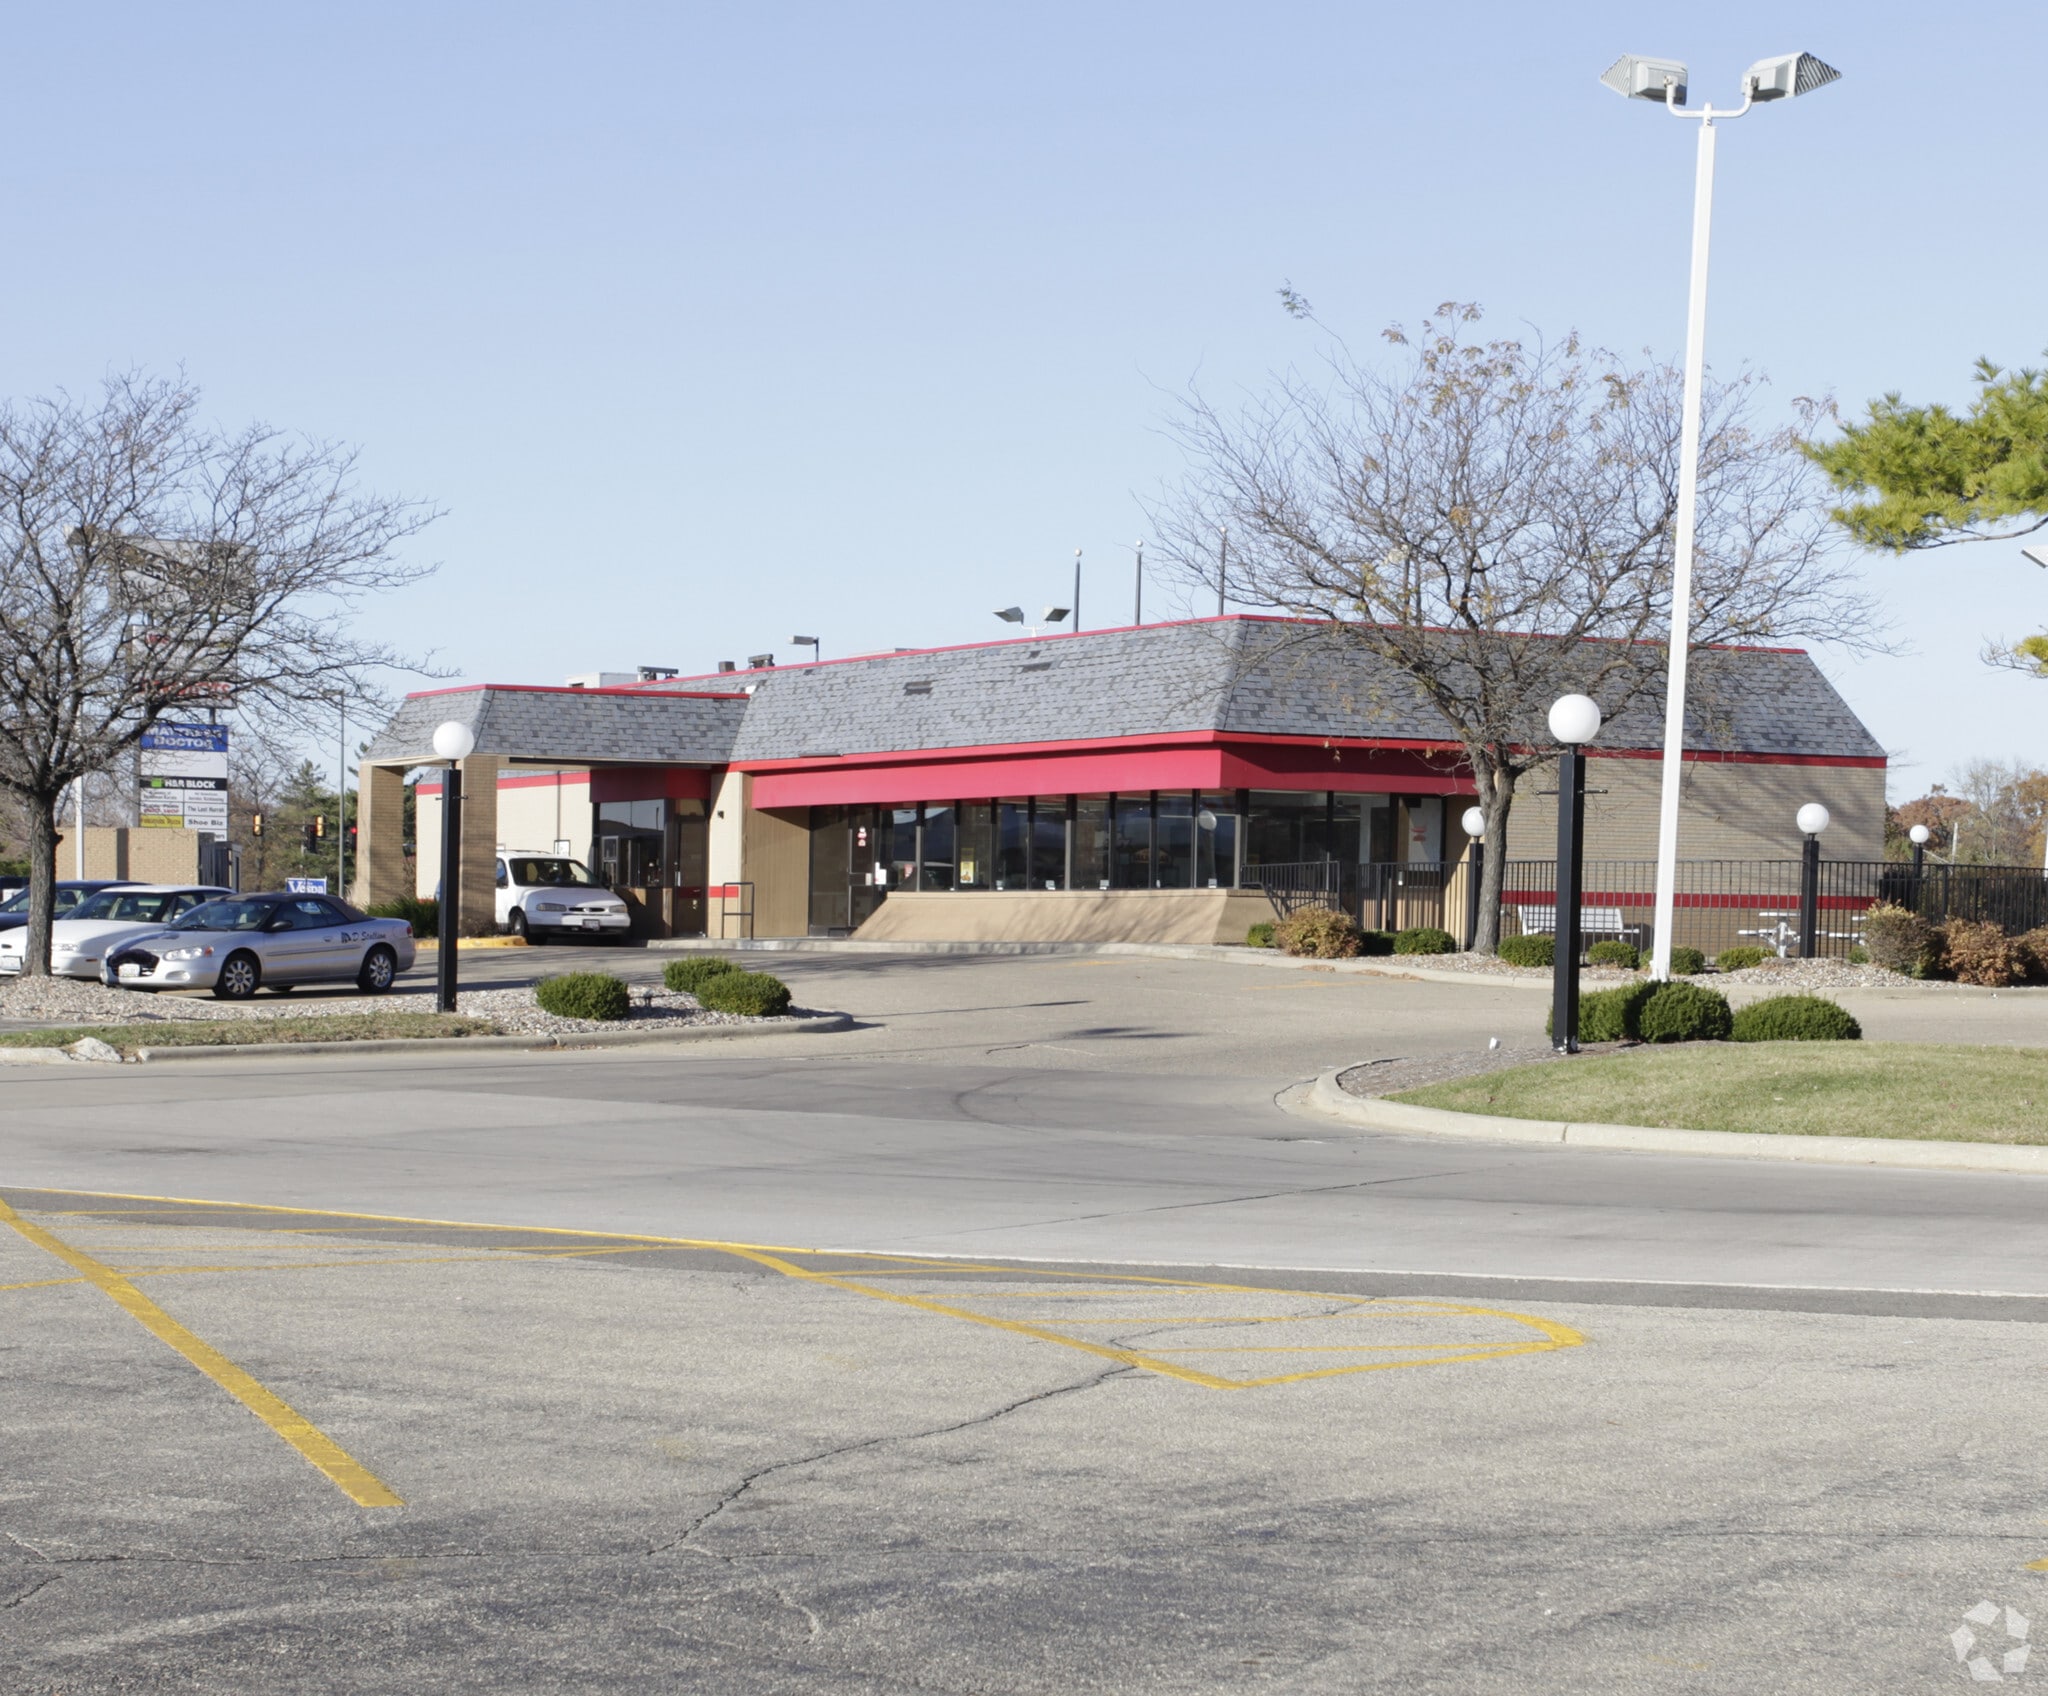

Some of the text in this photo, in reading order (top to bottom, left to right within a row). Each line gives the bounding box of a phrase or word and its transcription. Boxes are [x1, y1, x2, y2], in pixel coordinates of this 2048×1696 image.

[153, 735, 214, 750] DOCTOR
[164, 779, 216, 789] H&R BLOCK
